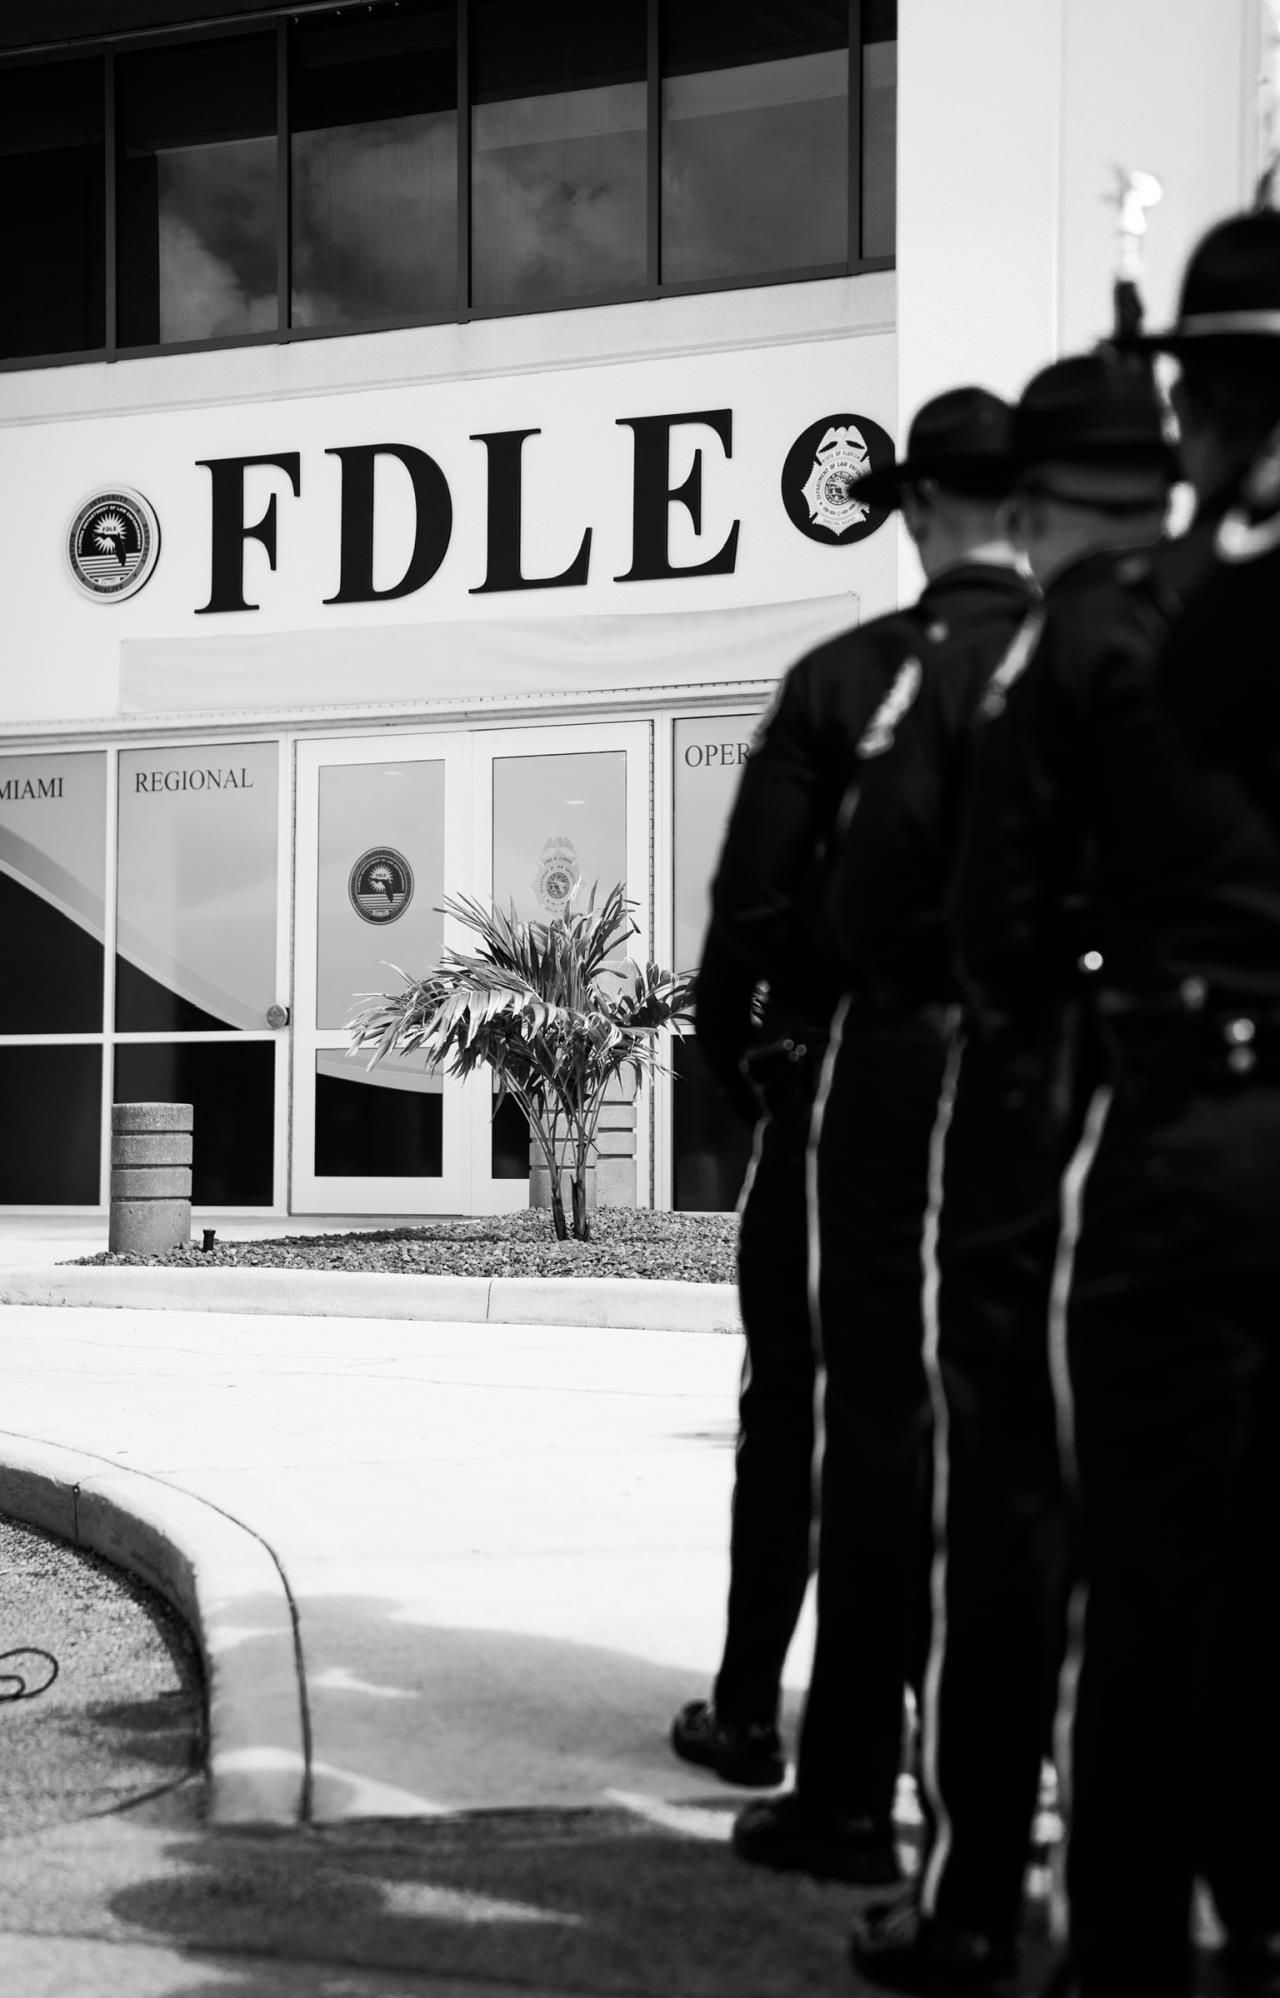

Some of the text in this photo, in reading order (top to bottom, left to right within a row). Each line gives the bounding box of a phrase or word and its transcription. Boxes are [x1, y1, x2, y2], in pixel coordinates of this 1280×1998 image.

[194, 408, 740, 614] FDLE
[0, 777, 64, 800] MIAMI
[135, 768, 254, 792] REGIONAL
